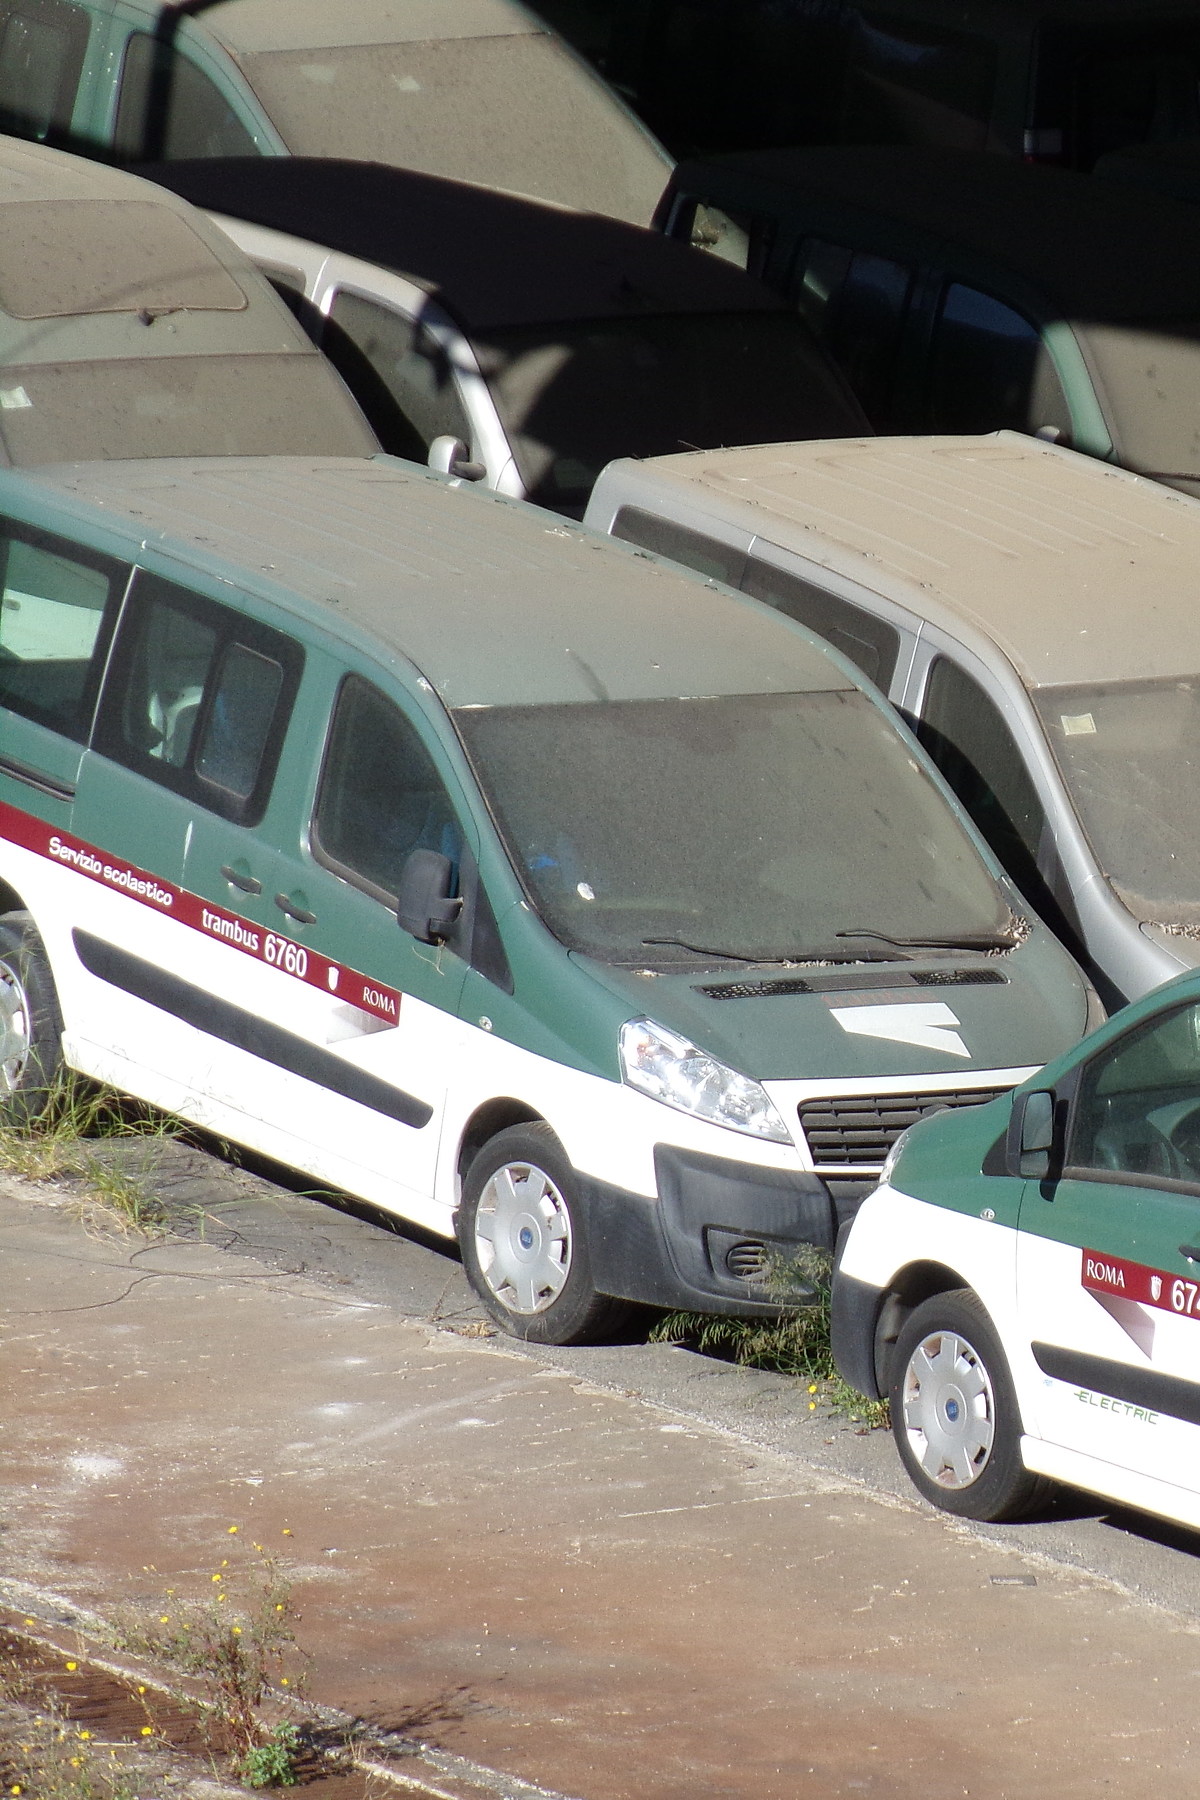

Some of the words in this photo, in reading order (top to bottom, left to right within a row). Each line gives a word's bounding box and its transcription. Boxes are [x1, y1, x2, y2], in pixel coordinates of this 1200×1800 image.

[48, 836, 103, 875] Servizio
[103, 865, 173, 906] scolastico
[202, 908, 260, 951] trambus
[264, 934, 308, 978] 6760
[363, 986, 397, 1015] ROMA
[1086, 1258, 1126, 1289] ROMA
[1073, 1390, 1160, 1426] ELECTRIC
